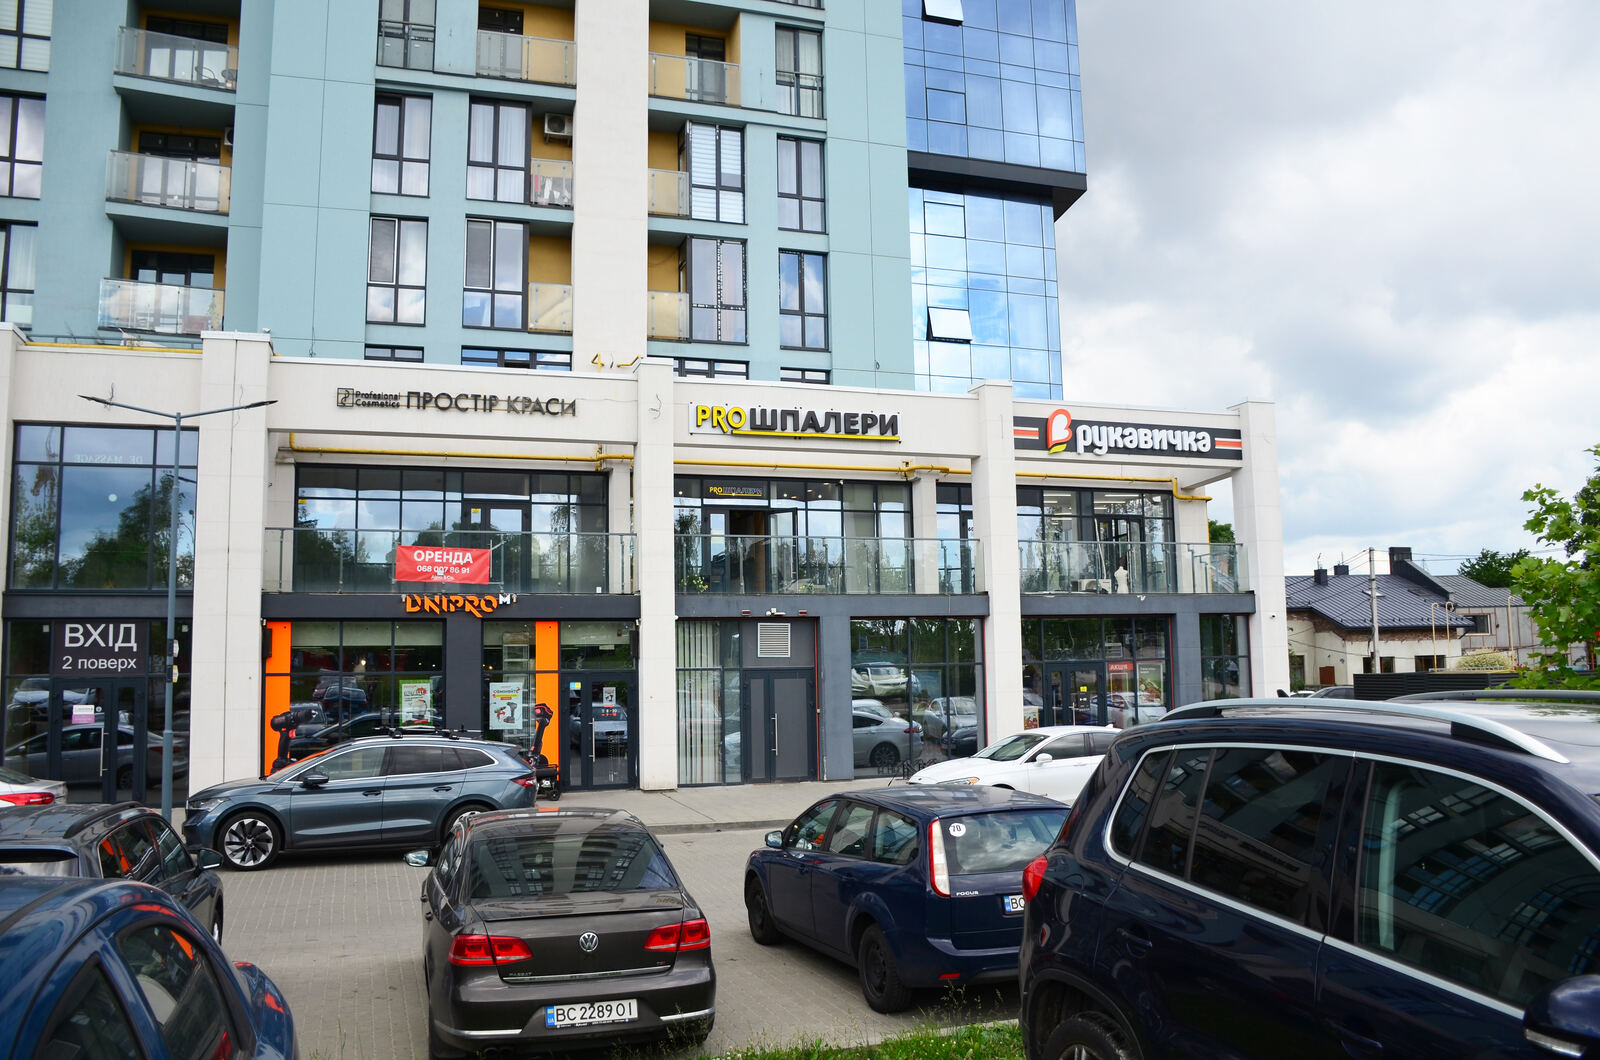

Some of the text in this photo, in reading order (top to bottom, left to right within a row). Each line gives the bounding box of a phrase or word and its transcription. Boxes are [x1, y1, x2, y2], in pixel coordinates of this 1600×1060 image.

[355, 398, 401, 408] Cosmetics
[406, 391, 577, 417] ПРОСТІР КРАСИ
[1076, 424, 1211, 456] рукавичка
[413, 550, 474, 565] ОРЕНДА
[64, 623, 138, 653] ВХІД
[61, 655, 137, 673] 2 поверх
[556, 1008, 577, 1022] BC
[579, 1004, 613, 1021] 2289
